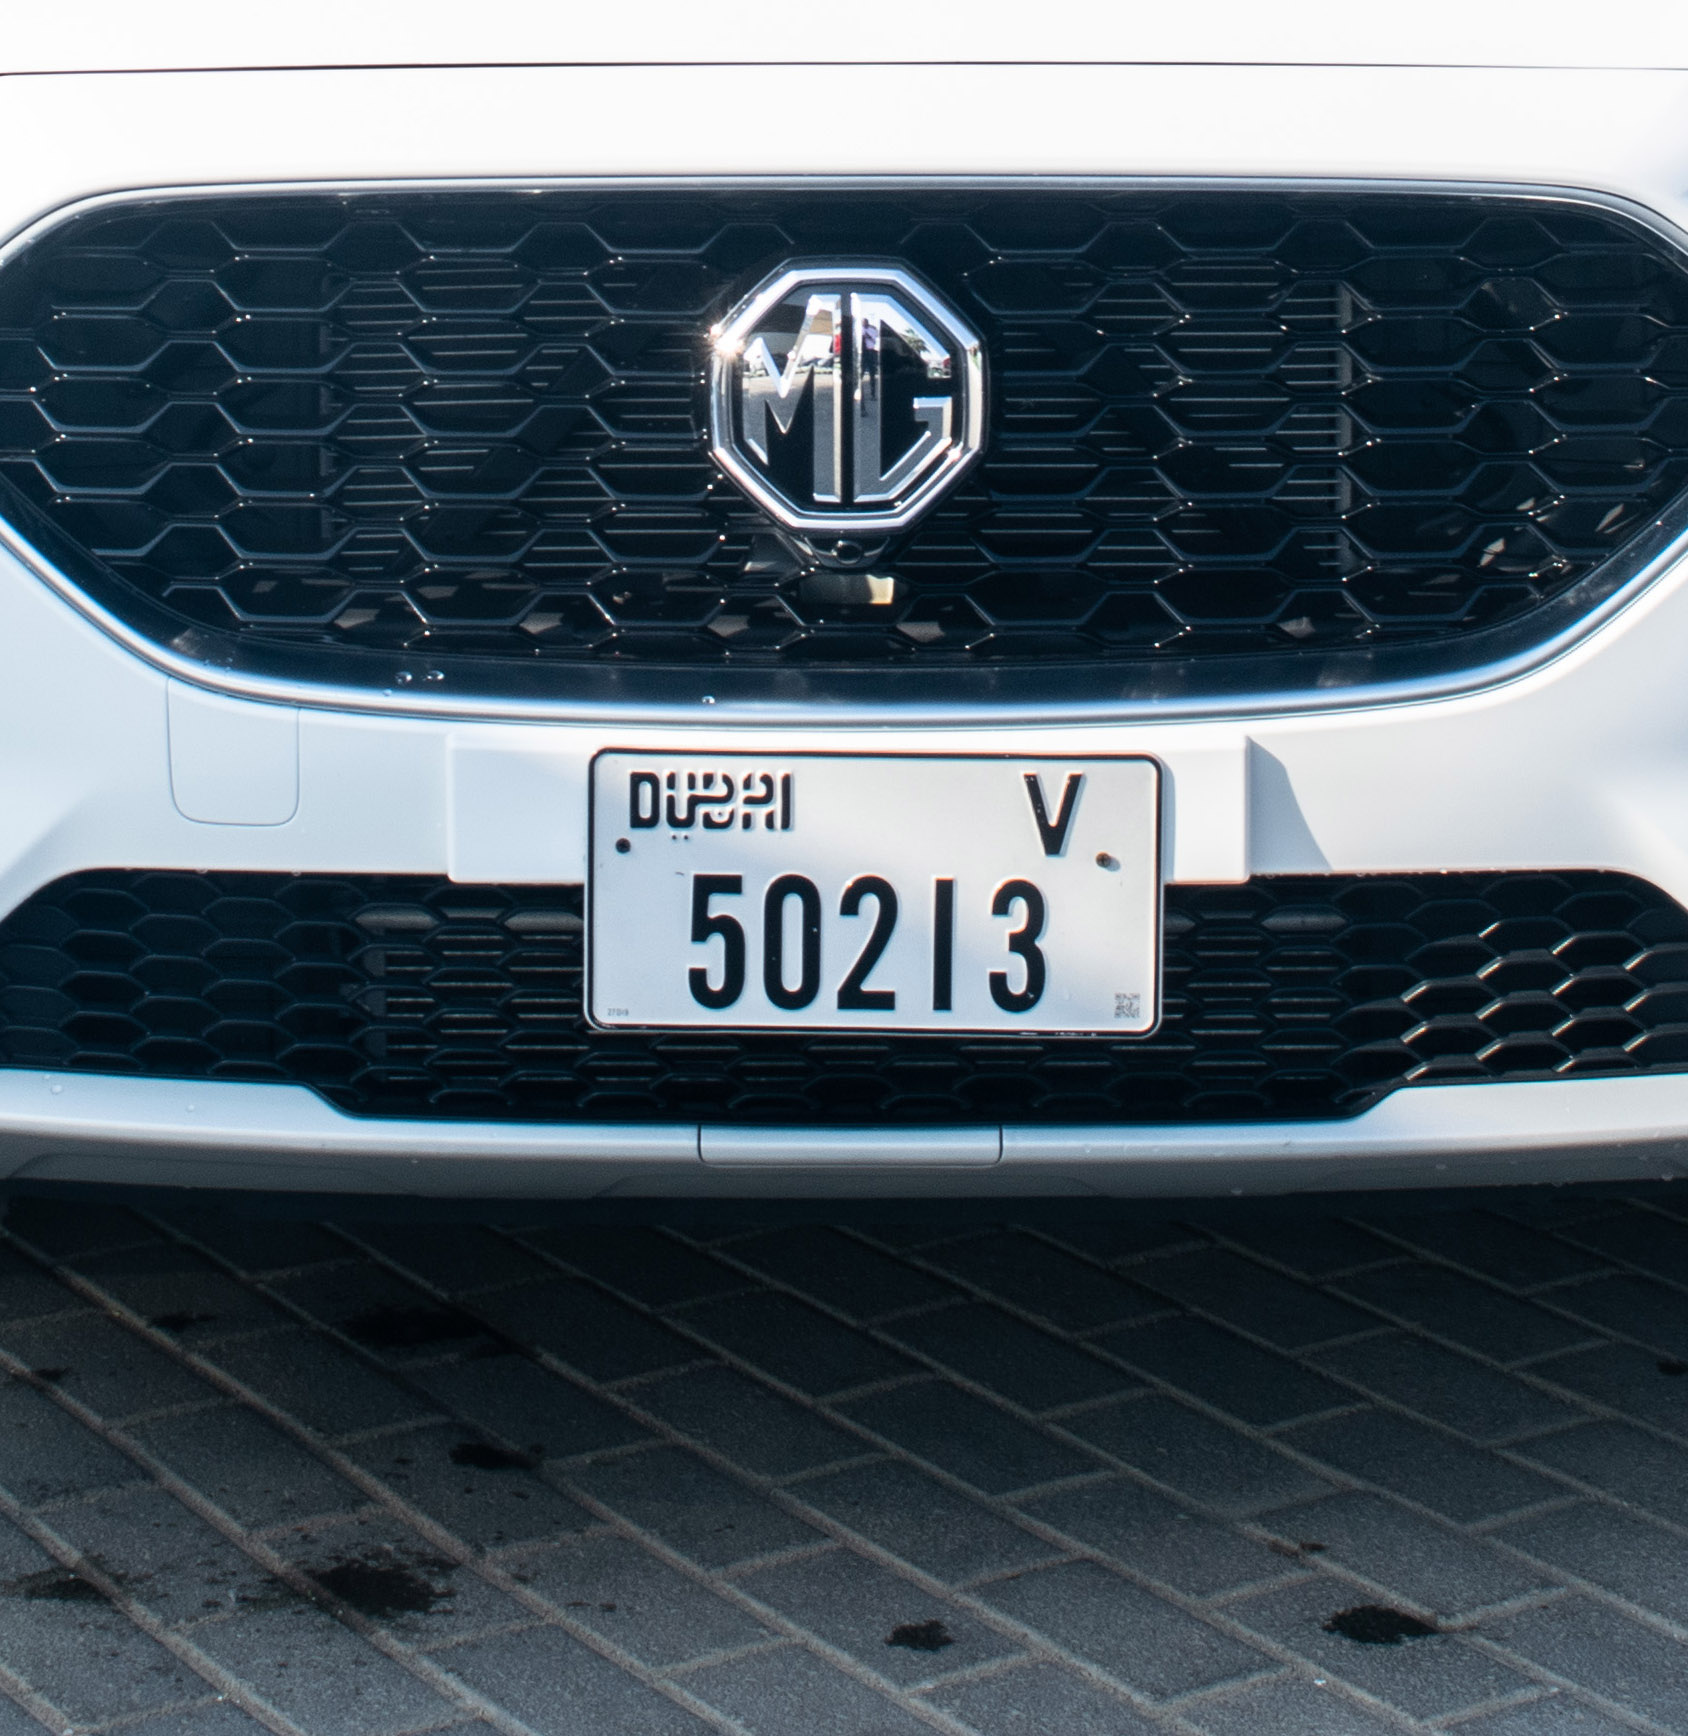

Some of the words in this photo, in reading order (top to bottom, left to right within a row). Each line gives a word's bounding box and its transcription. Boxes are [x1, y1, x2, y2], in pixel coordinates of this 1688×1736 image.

[742, 292, 952, 503] MG
[630, 771, 792, 831] DUBAI
[1023, 772, 1085, 856] V
[687, 873, 1047, 1013] 50213
